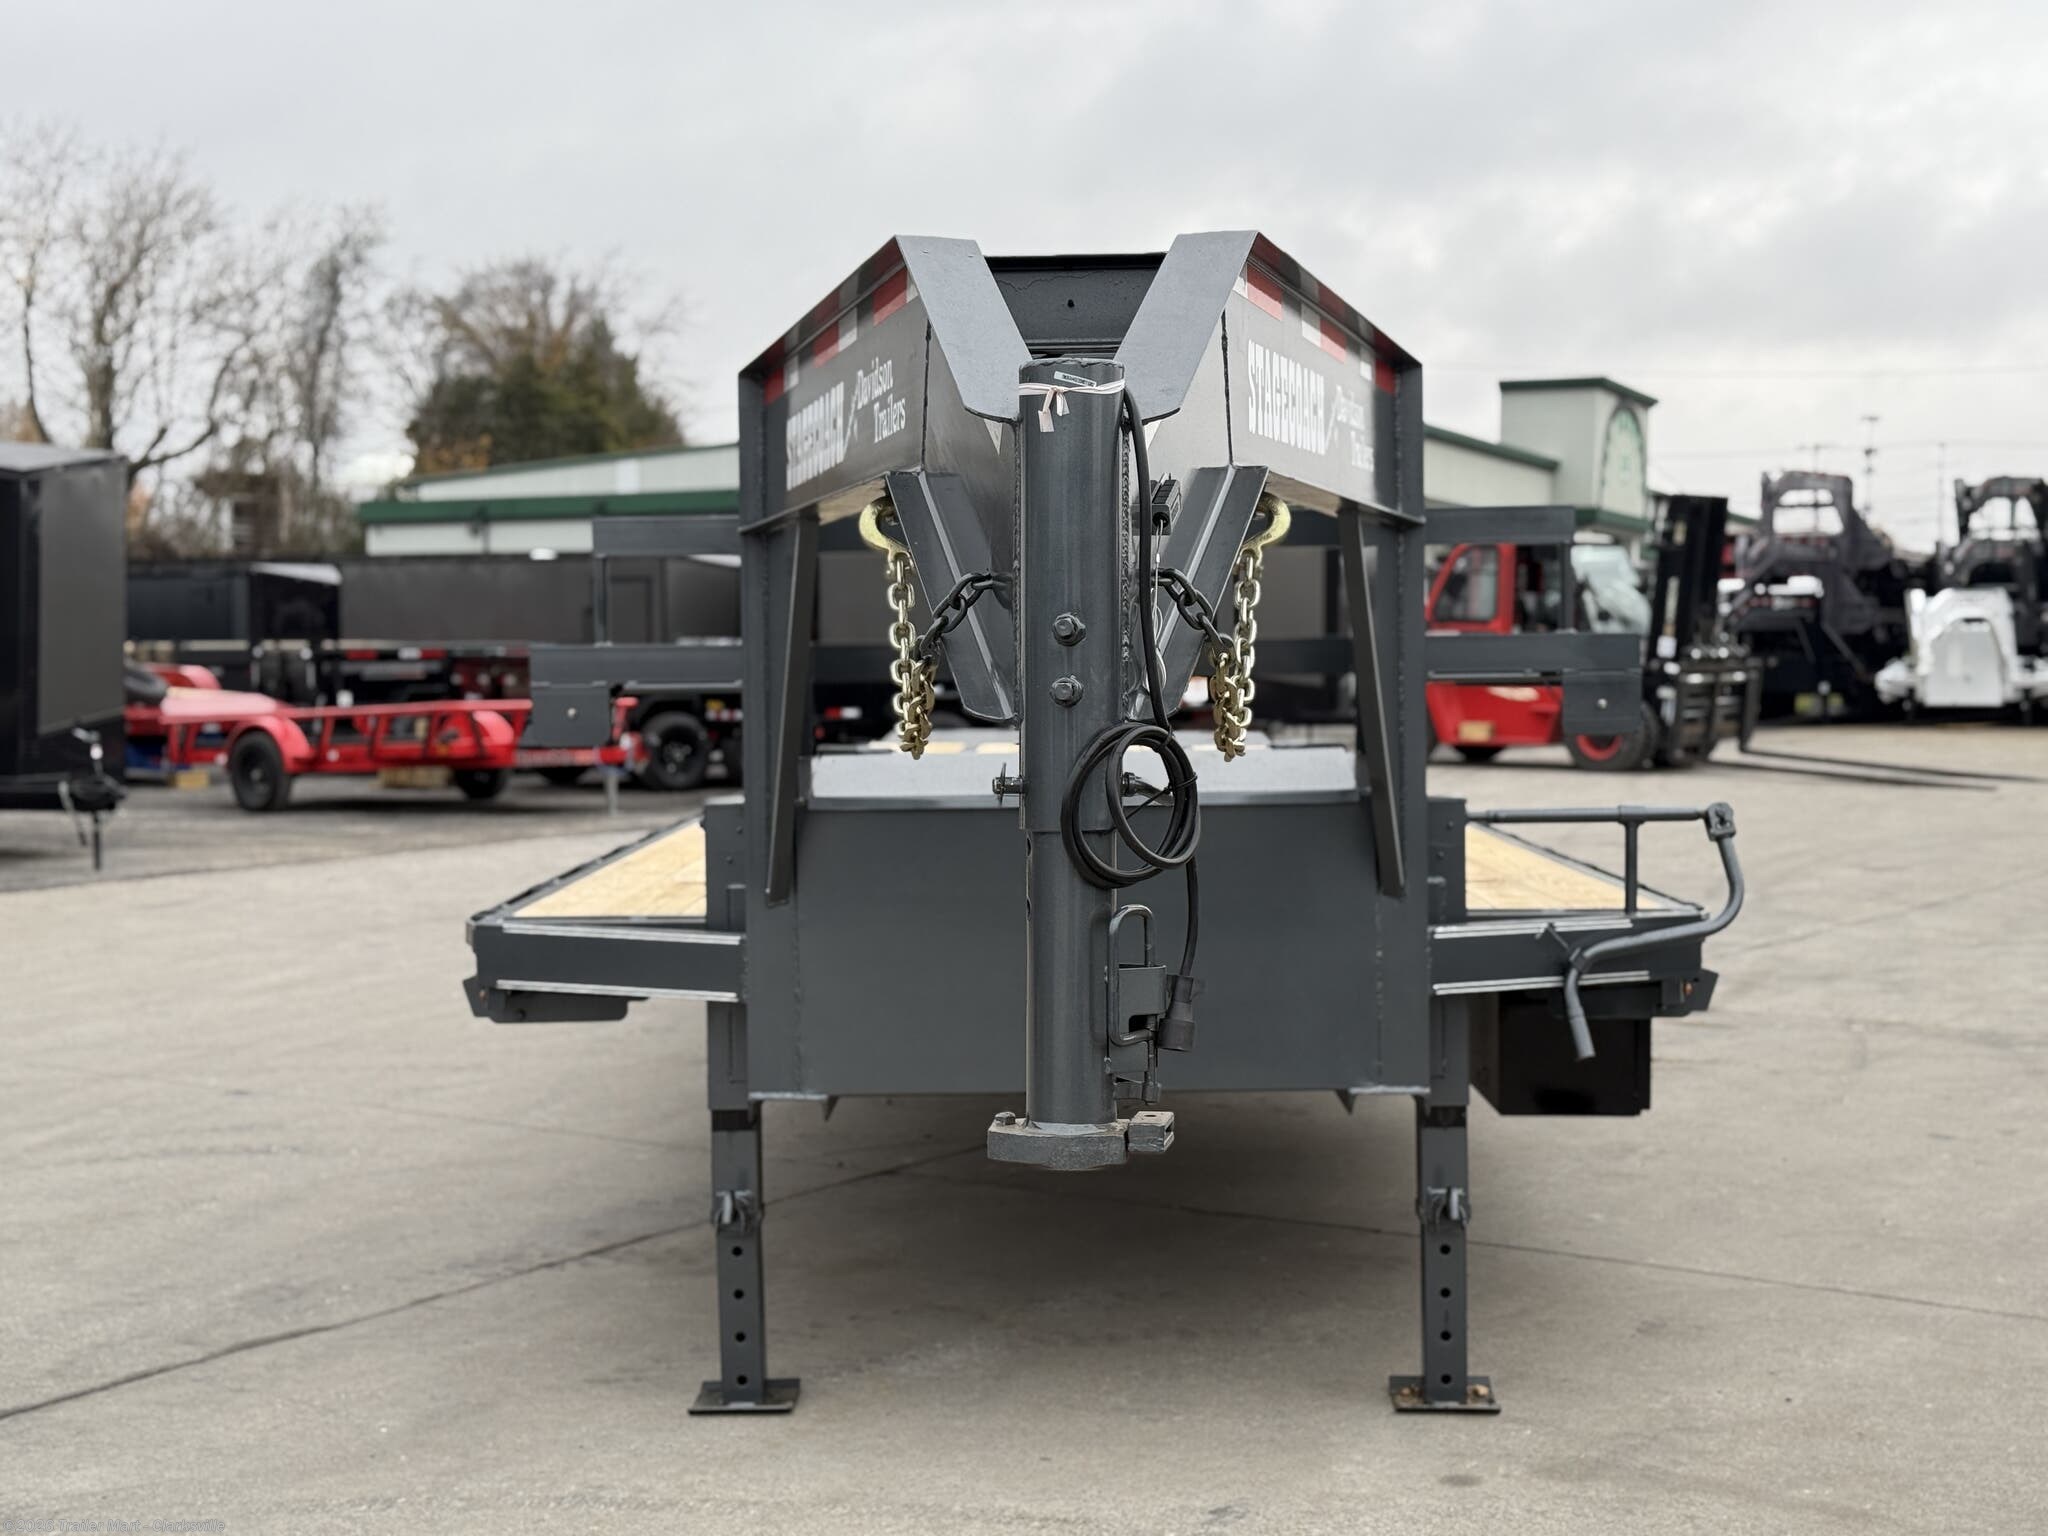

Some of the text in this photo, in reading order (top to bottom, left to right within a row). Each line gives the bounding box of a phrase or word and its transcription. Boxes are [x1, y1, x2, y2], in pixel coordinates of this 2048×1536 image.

[856, 357, 894, 410] Davidson
[1247, 339, 1326, 456] STAGECOACH
[873, 393, 907, 444] Trailers
